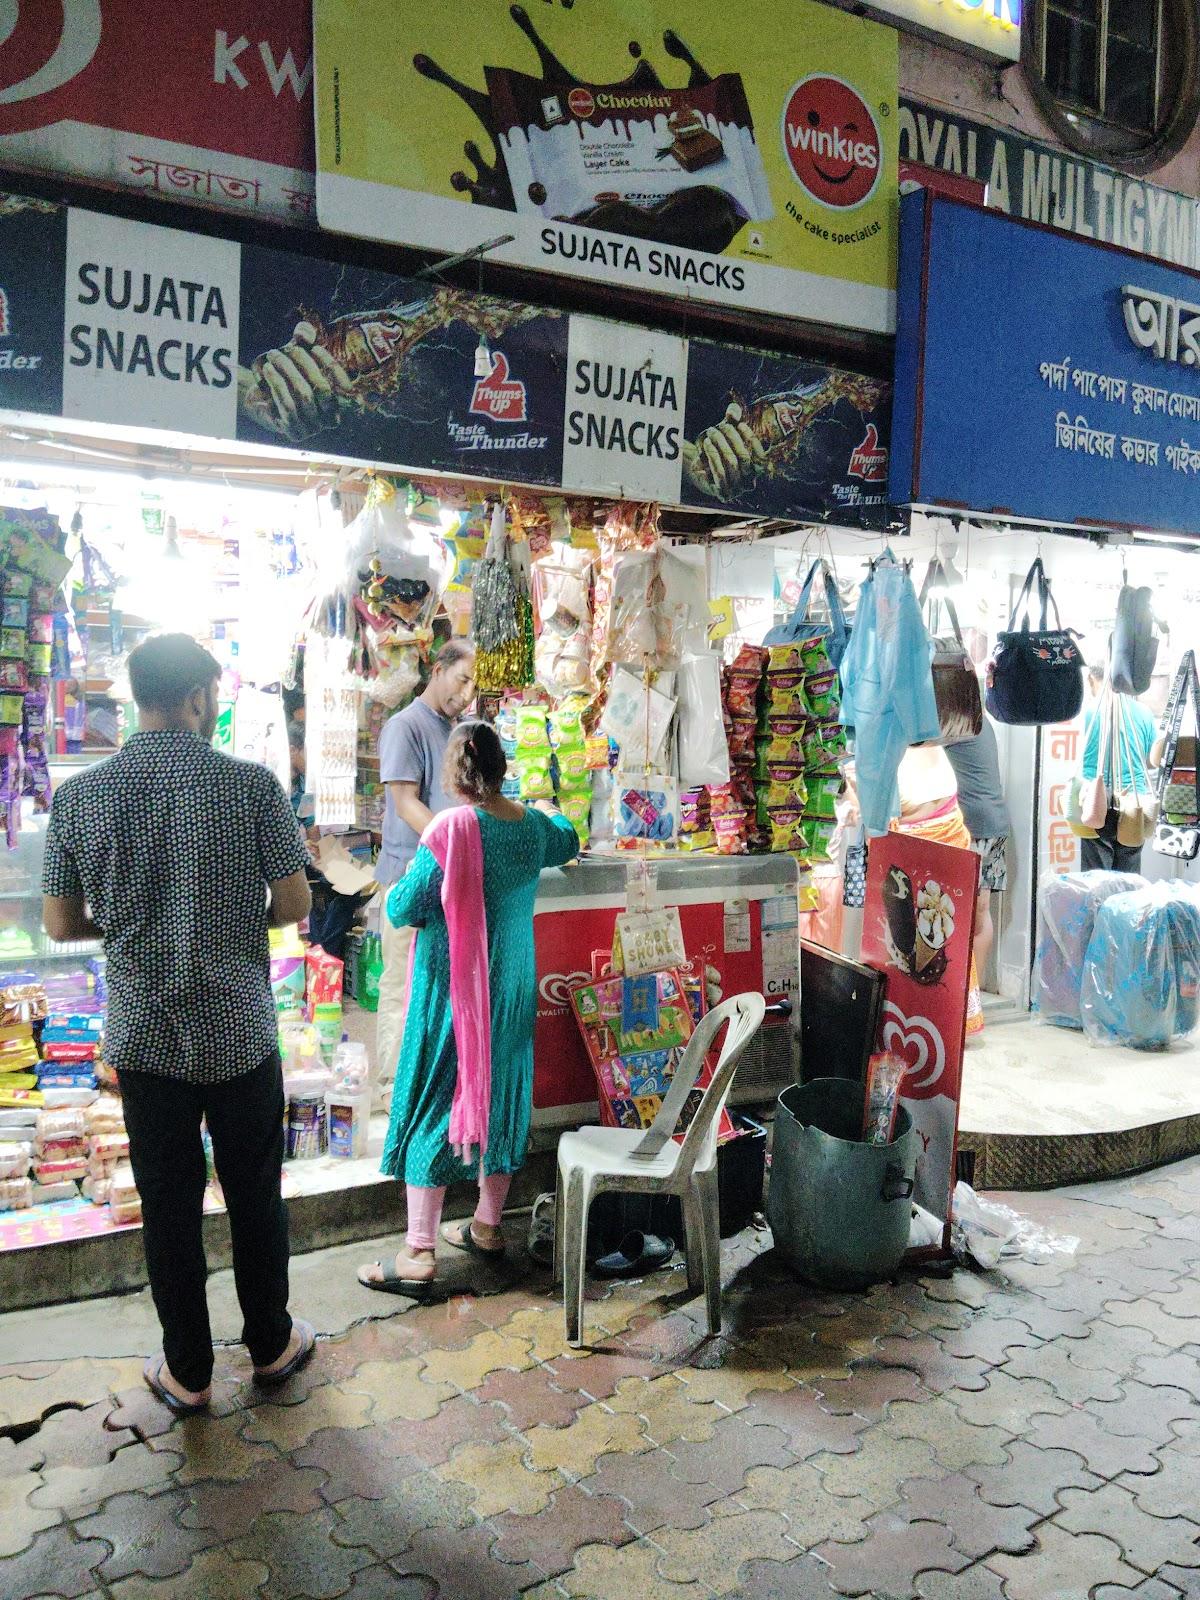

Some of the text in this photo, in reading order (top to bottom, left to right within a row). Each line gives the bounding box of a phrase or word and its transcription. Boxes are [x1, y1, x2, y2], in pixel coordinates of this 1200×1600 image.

[609, 159, 631, 167] Cake
[785, 201, 882, 246] the cake specialist
[541, 228, 746, 292] SUJATA SNACKS
[77, 262, 228, 329] SUJATA
[69, 324, 233, 389] SNACKS
[574, 359, 678, 411] SUJATA
[447, 422, 486, 436] Taste
[470, 432, 548, 450] Thunder
[567, 410, 680, 461] SNACKS
[1120, 435, 1160, 466] কভার
[832, 484, 859, 494] Taste
